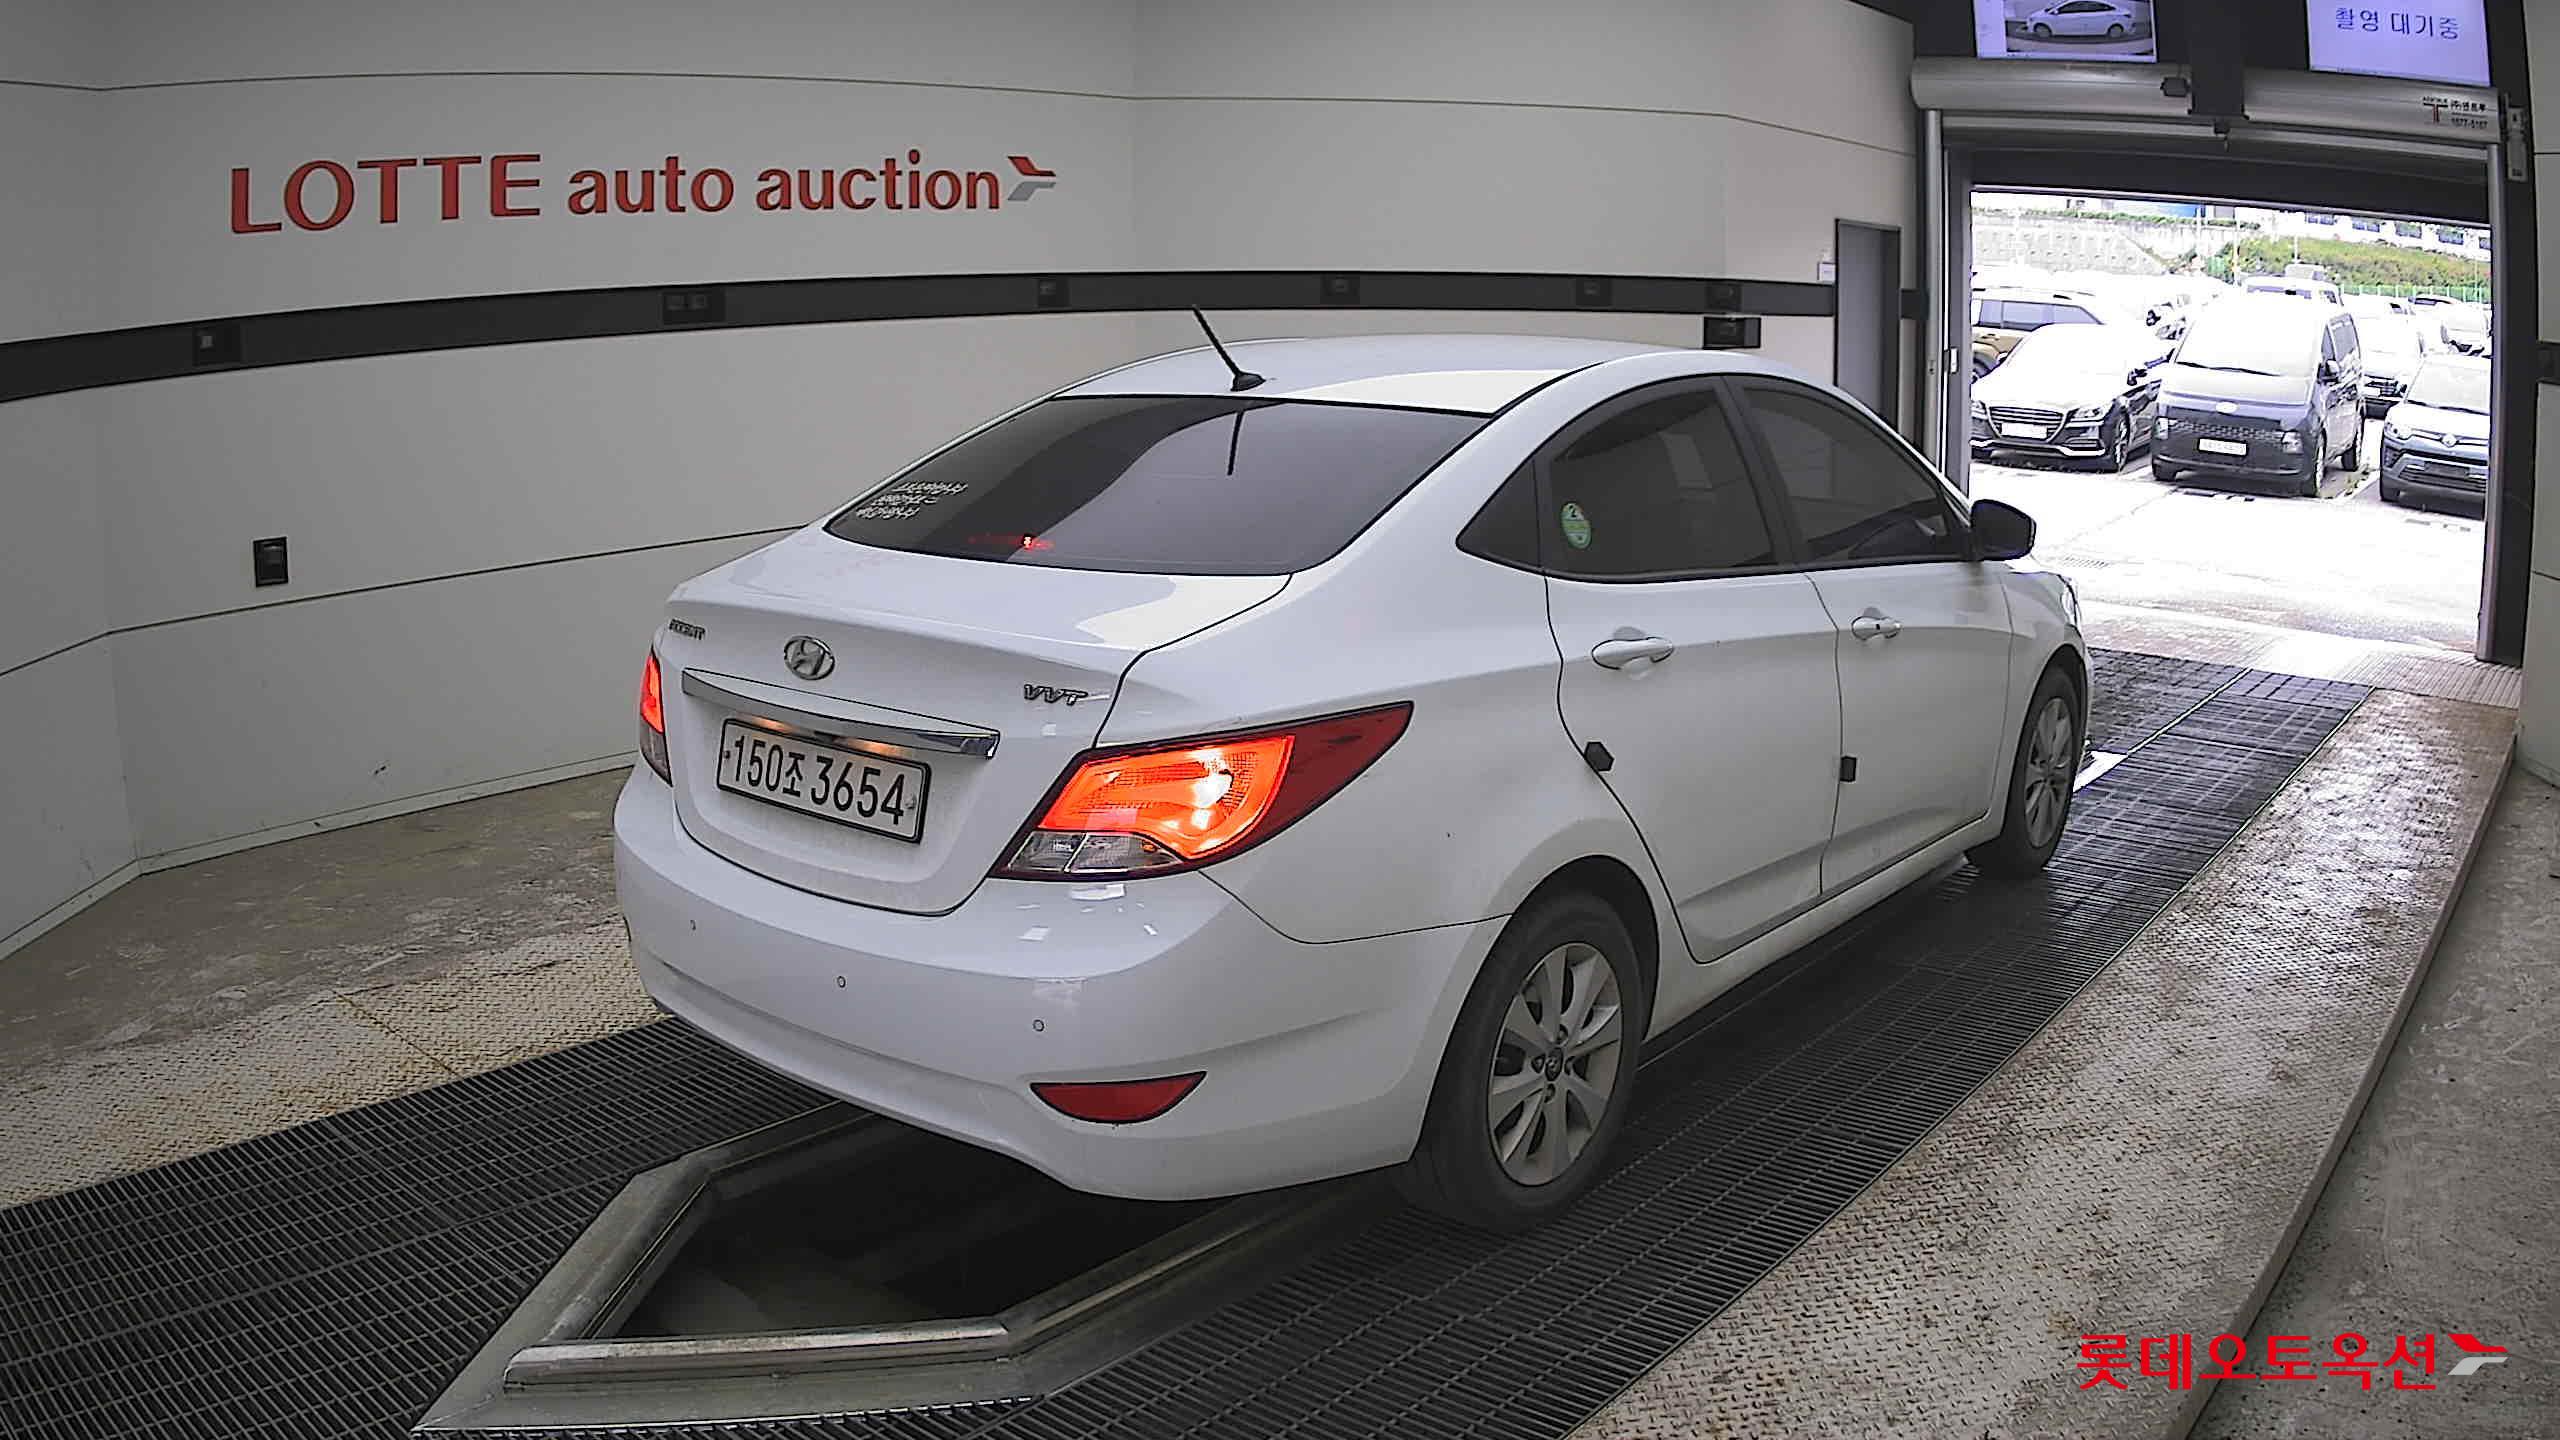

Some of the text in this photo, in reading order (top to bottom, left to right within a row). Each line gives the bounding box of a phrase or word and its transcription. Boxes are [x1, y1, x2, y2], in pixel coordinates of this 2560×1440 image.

[2335, 7, 2459, 40] 촬영 대기중
[230, 149, 1001, 234] LOTTE auto auction
[1024, 683, 1089, 706] VVT
[734, 735, 906, 826] 150조 3654
